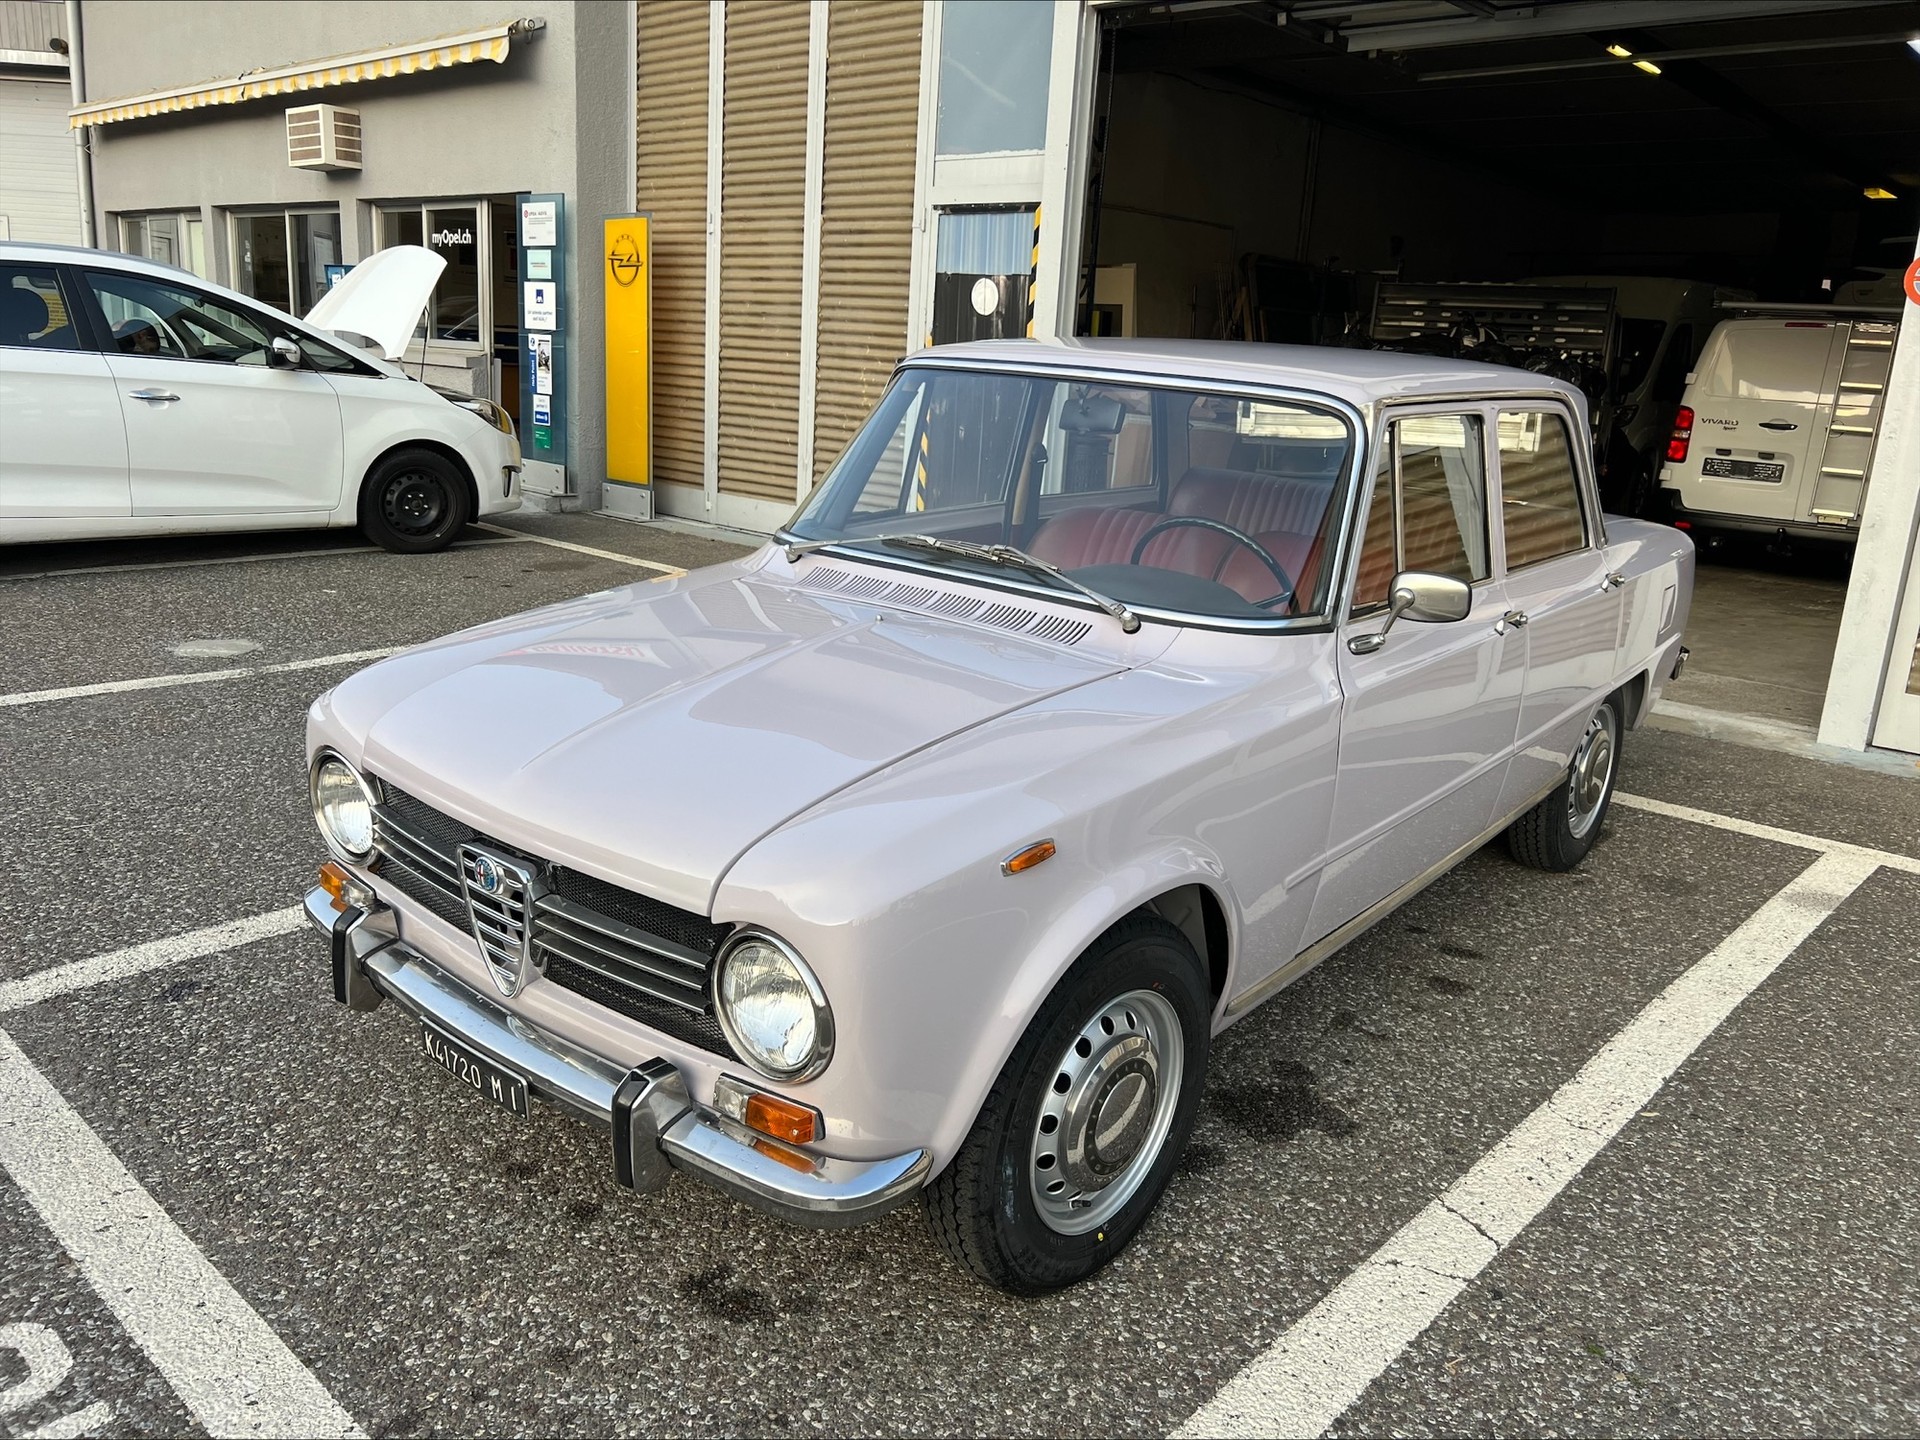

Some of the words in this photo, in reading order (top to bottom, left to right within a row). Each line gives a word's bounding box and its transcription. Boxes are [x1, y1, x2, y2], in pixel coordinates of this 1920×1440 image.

[432, 228, 472, 247] myOpel.ch
[1701, 417, 1739, 426] VIVARO
[424, 1031, 482, 1089] K41720
